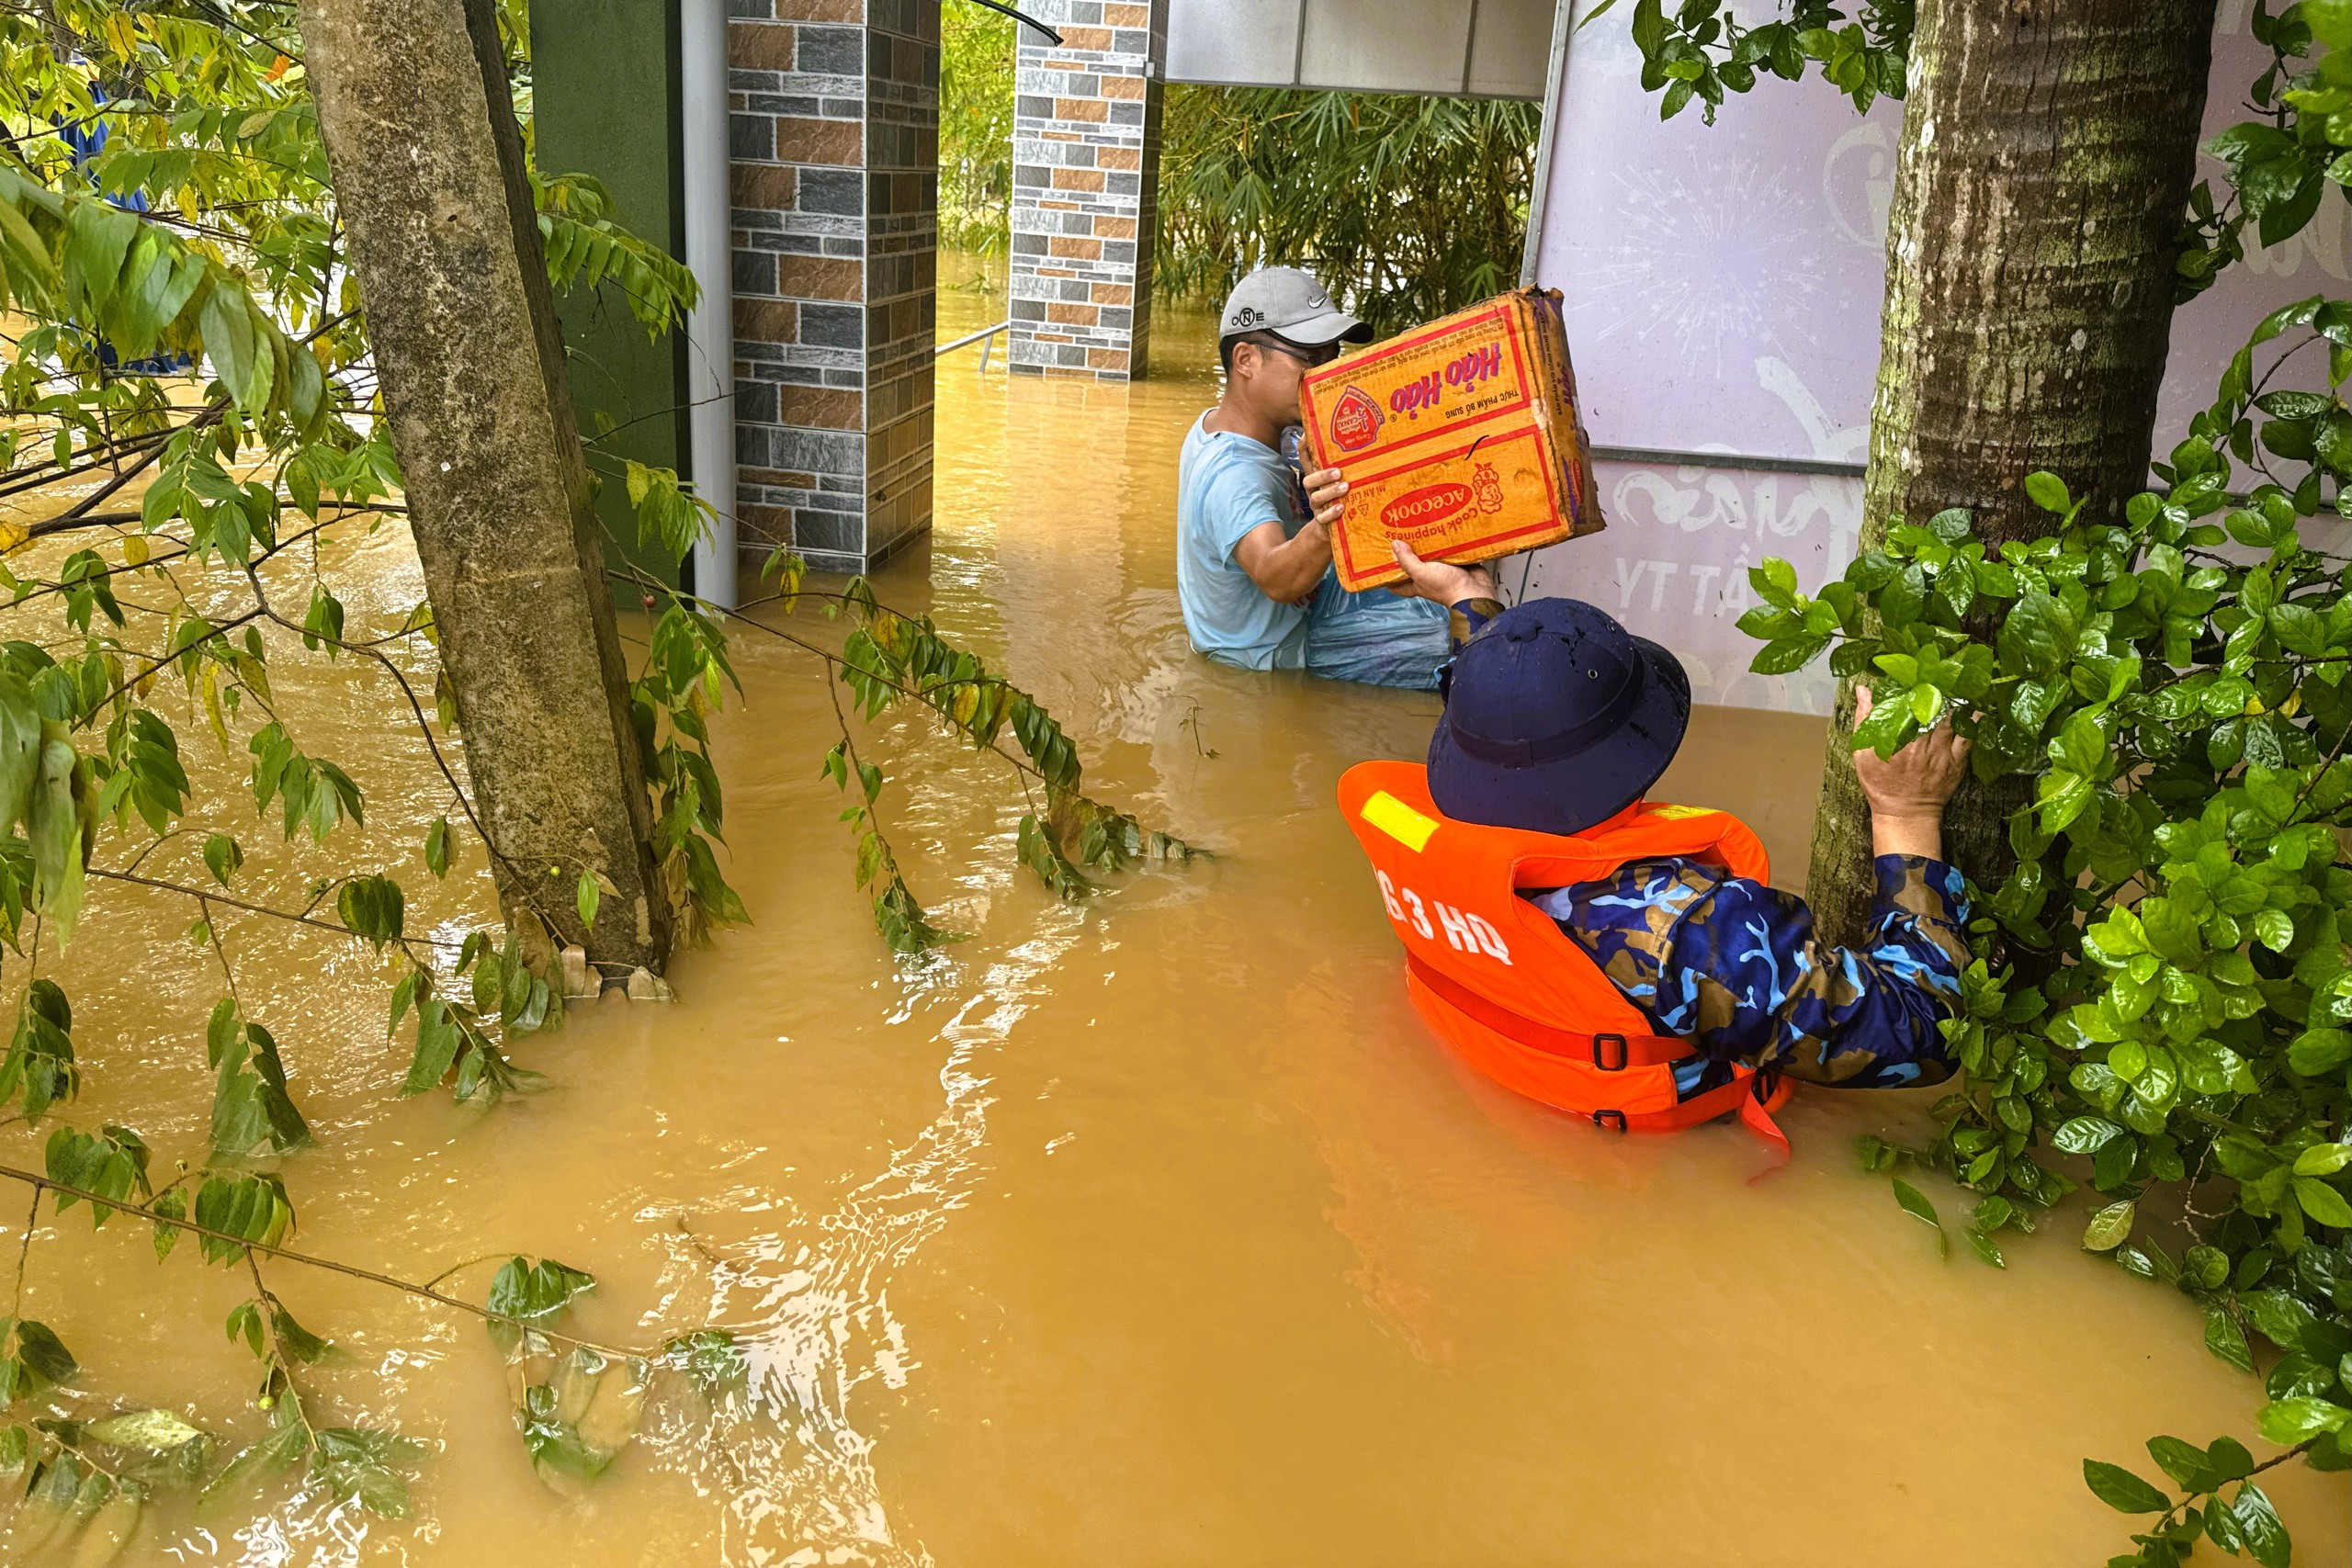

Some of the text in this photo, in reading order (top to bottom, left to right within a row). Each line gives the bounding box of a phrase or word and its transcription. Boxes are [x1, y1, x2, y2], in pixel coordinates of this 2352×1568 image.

[1231, 307, 1264, 327] ONE
[1446, 343, 1503, 393] Hảo
[1389, 371, 1442, 420] Hảo
[1476, 395, 1498, 410] PHẨM
[1498, 389, 1520, 401] THỰC
[1444, 406, 1464, 419] SUNG
[1385, 507, 1478, 543] Cook happiness
[1433, 900, 1514, 965] HQ
